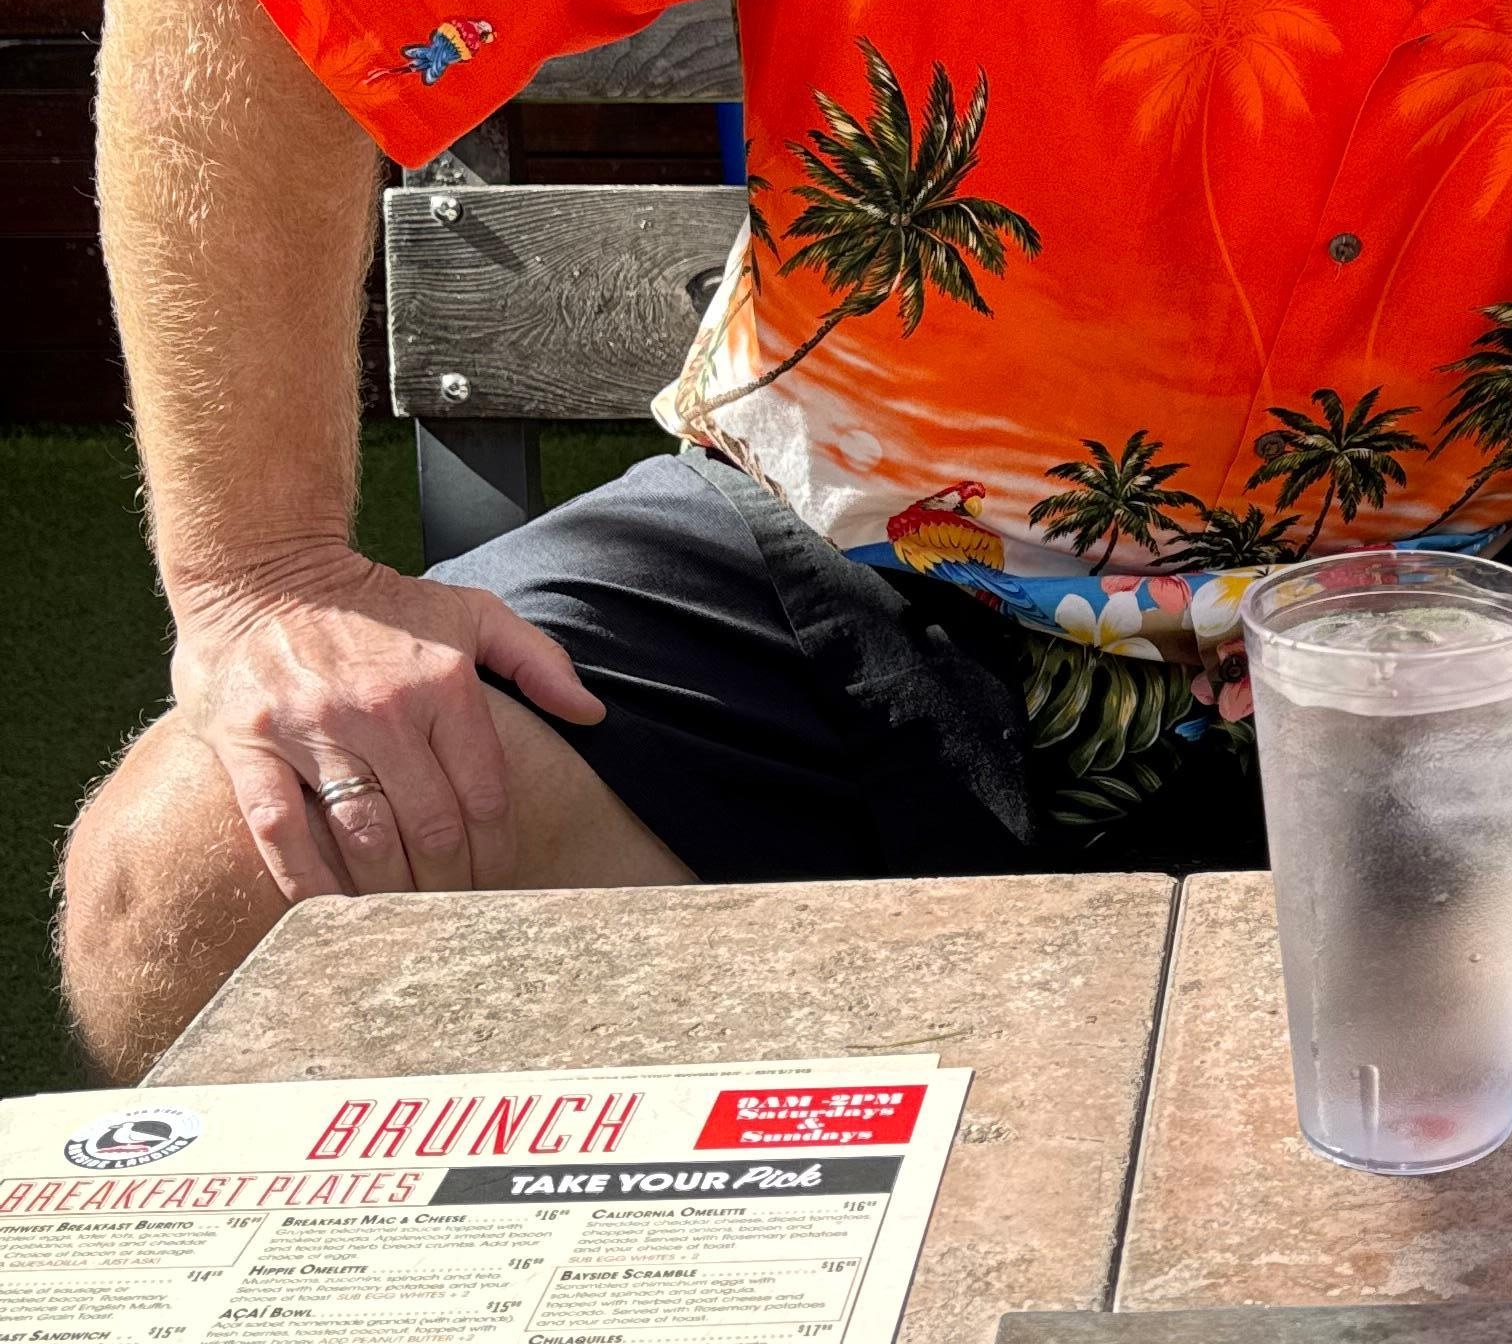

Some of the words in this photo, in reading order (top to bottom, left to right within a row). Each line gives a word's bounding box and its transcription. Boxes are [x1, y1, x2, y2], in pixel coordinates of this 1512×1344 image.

[306, 1091, 645, 1160] BRUNCH
[736, 1105, 895, 1120] Saturdays
[796, 1117, 825, 1130] &
[740, 1128, 873, 1143] Sundays
[113, 1139, 190, 1168] LANDING
[0, 1174, 258, 1213] BREAKFAST
[257, 1170, 424, 1207] PLATES
[510, 1173, 611, 1195] TAKE
[619, 1171, 730, 1193] YOUR
[732, 1164, 823, 1190] Pick
